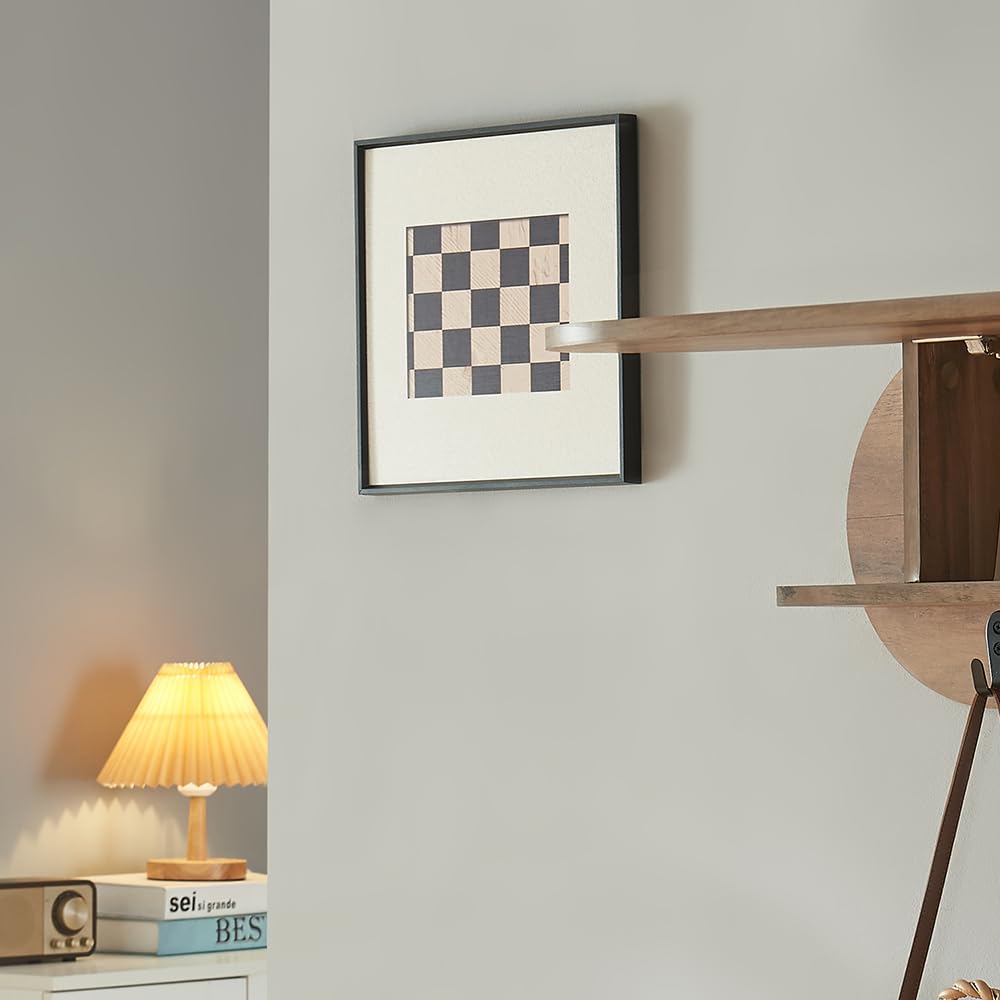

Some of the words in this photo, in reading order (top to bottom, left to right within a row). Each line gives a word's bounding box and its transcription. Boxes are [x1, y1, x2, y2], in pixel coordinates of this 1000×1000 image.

[169, 891, 196, 912] sei
[197, 901, 205, 911] si
[207, 899, 236, 912] grande
[216, 914, 265, 943] BES
